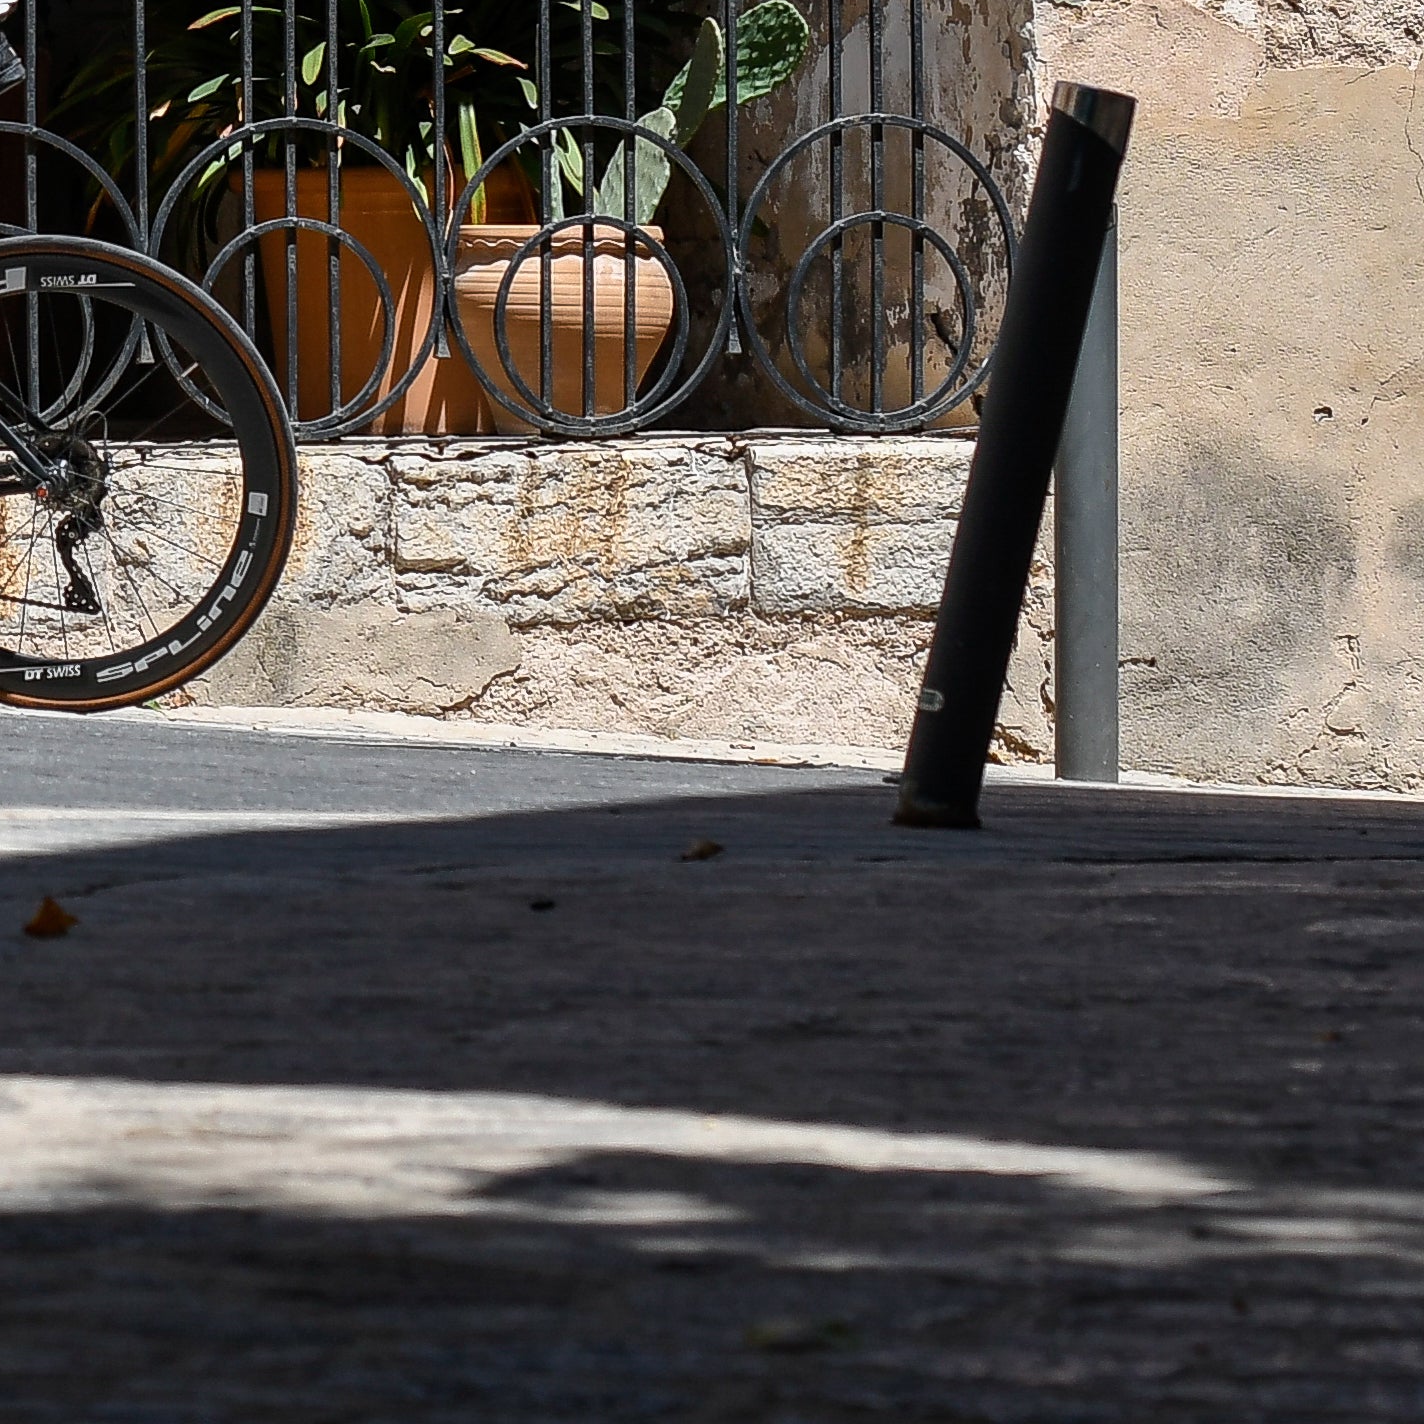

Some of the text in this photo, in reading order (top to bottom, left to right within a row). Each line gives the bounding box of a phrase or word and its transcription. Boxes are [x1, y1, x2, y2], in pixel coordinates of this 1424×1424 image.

[39, 273, 97, 287] DT SWISS
[24, 664, 82, 681] DT SWISS
